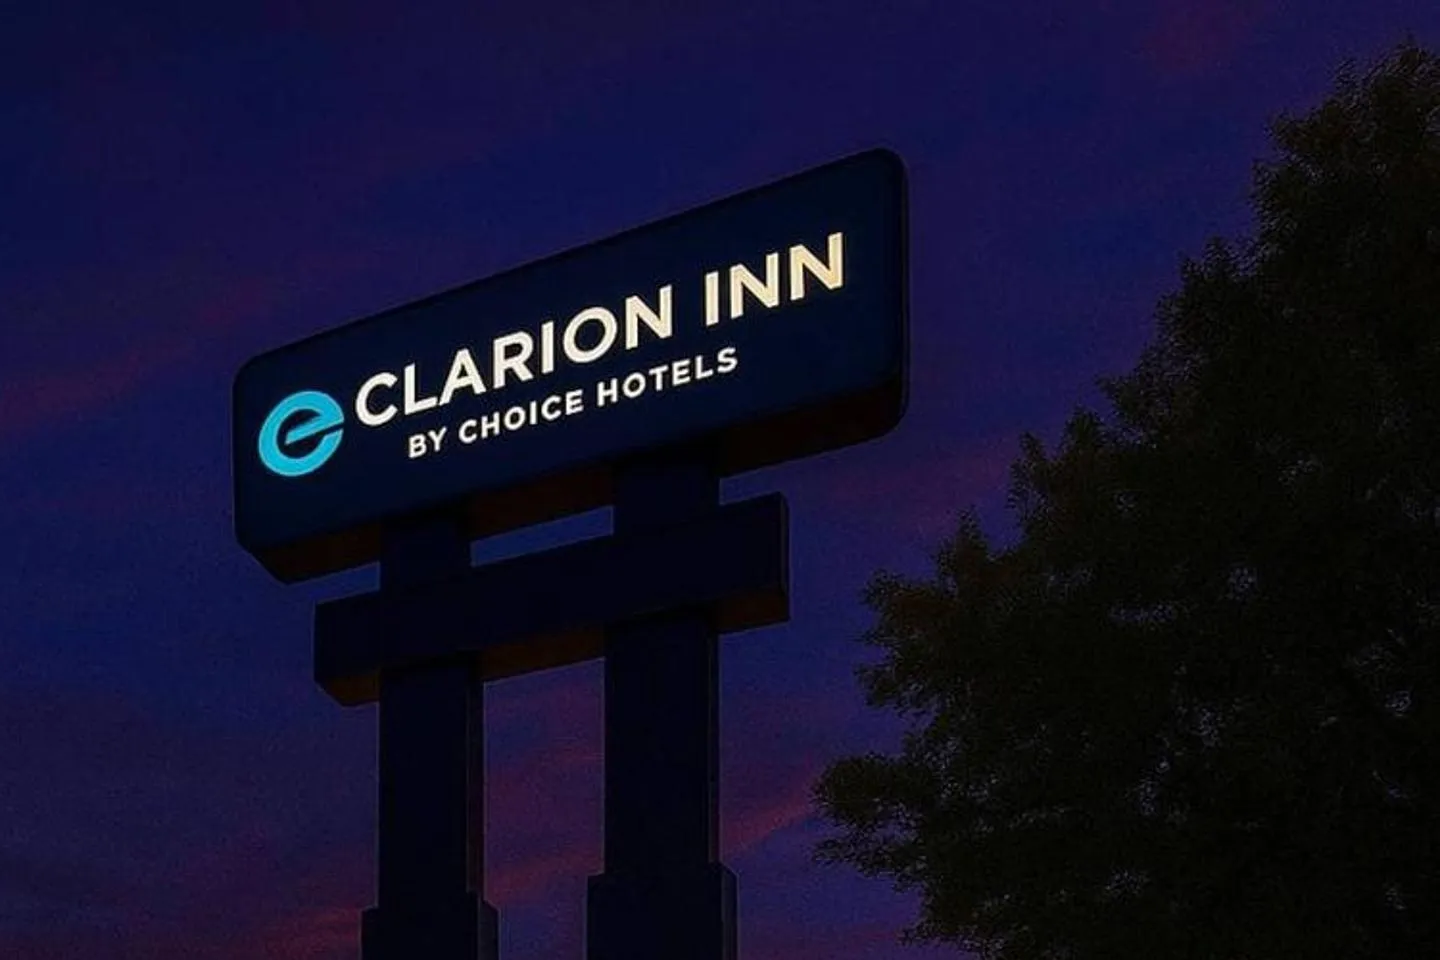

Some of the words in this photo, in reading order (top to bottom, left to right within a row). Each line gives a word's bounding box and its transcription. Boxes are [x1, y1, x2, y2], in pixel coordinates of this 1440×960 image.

[354, 284, 673, 427] CLARION
[704, 232, 844, 327] INN
[408, 425, 448, 459] BY
[457, 388, 585, 445] CHOICE
[596, 347, 739, 408] HOTELS
